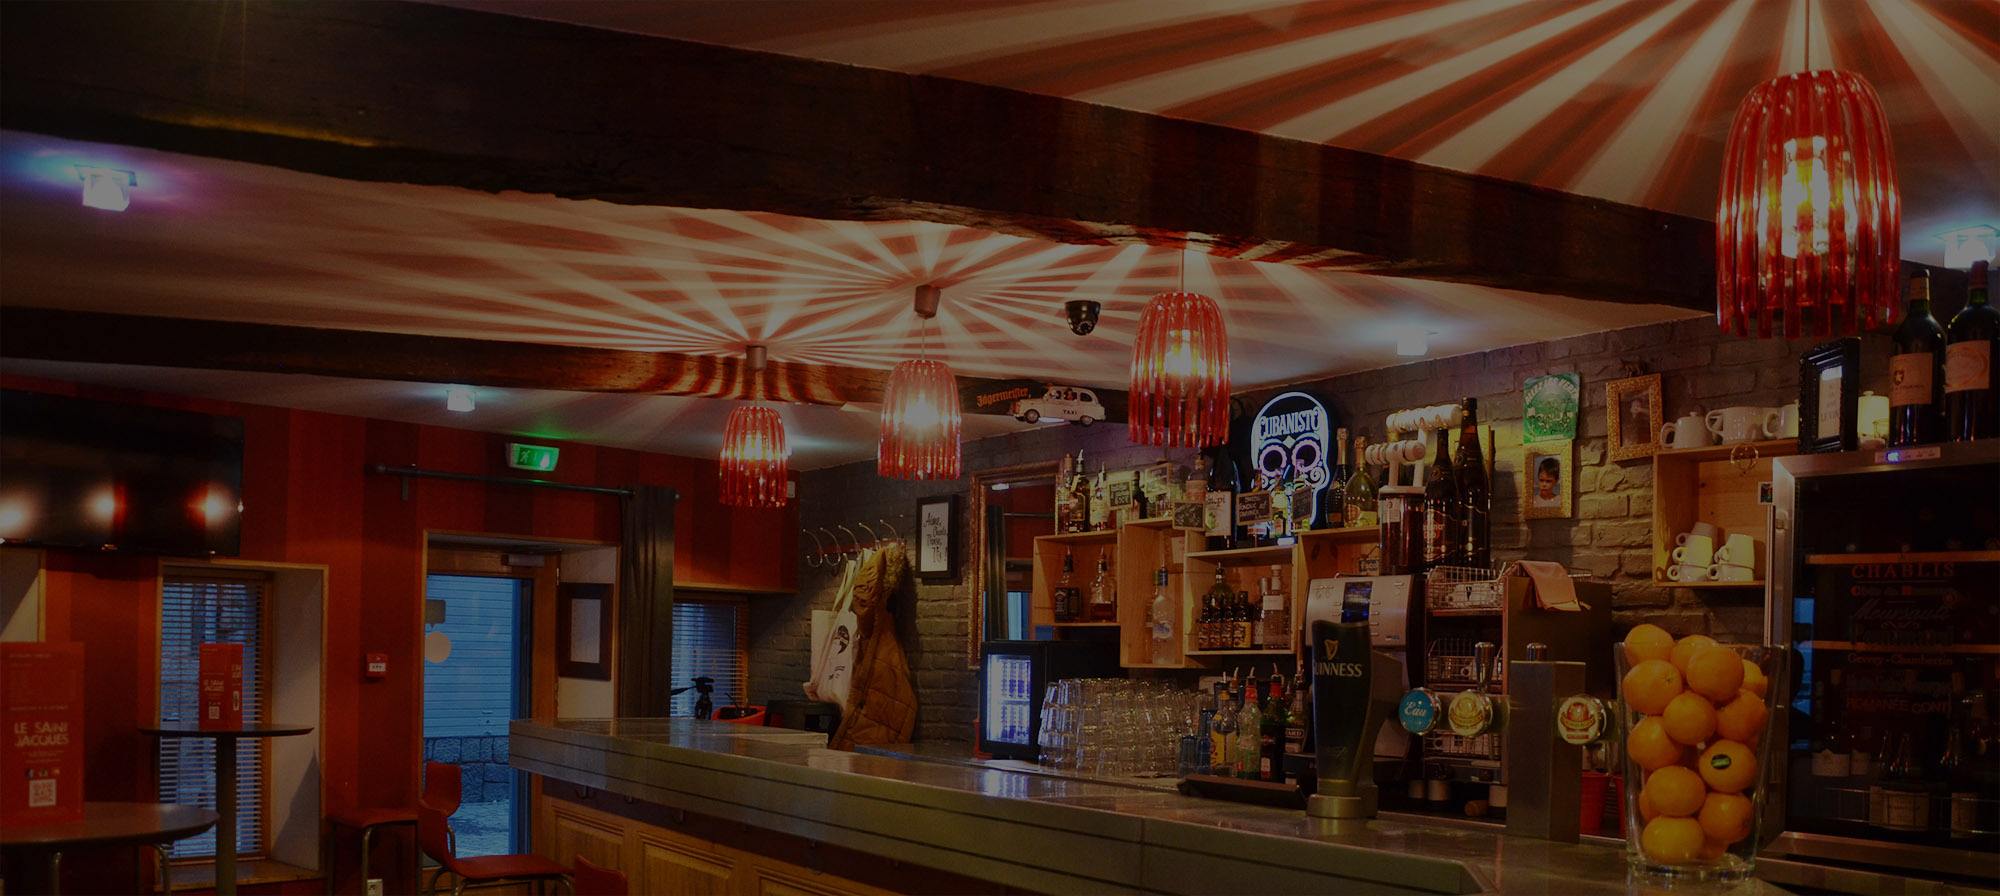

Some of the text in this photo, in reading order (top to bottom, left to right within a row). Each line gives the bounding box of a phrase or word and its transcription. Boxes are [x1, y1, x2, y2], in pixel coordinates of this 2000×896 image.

[1259, 406, 1320, 440] CUBANISTO
[1852, 562, 1955, 579] CHABLIS
[1314, 662, 1363, 678] UINNESS
[1404, 701, 1427, 717] Eau
[14, 720, 69, 734] LE SAINT
[14, 733, 70, 748] JACQUES
